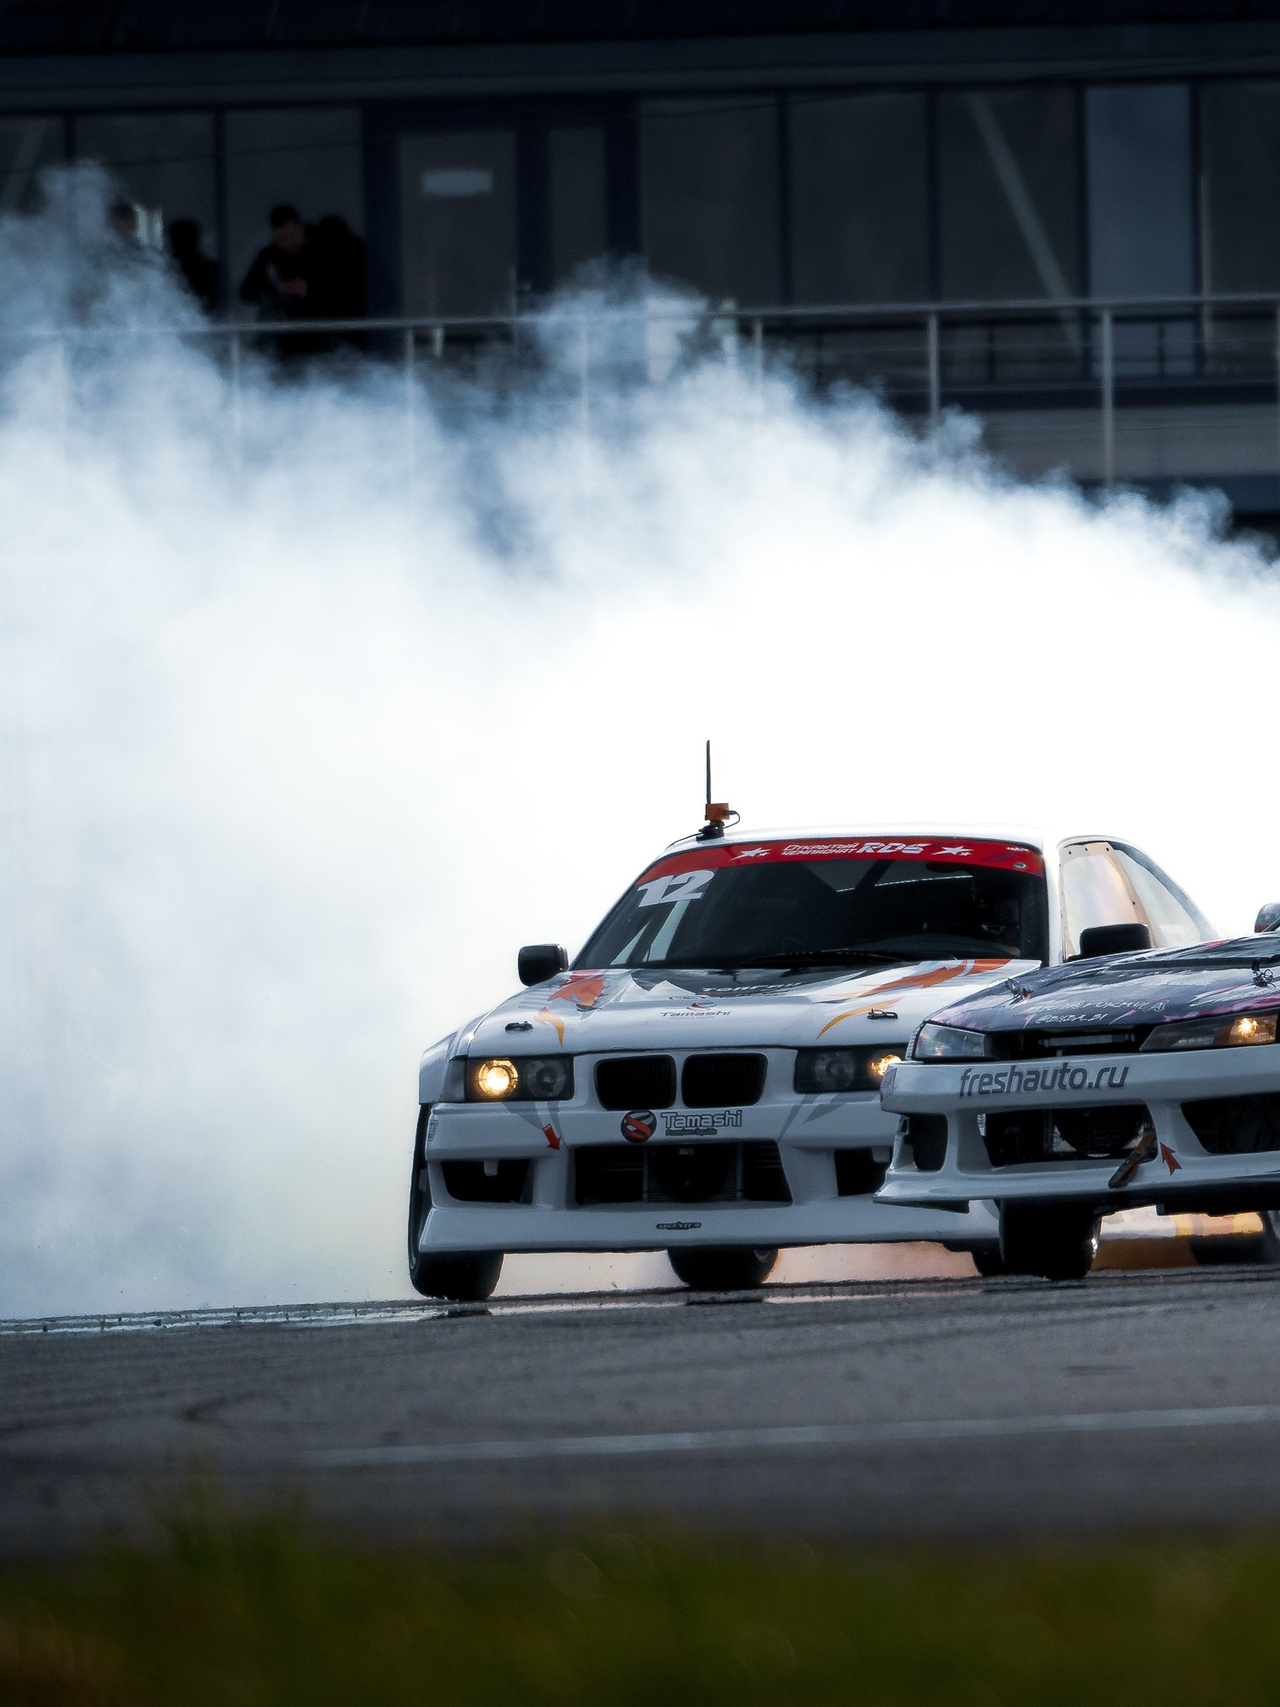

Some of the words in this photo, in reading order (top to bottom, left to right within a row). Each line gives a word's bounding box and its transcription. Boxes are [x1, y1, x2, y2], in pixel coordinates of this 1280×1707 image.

[856, 842, 931, 854] RDS
[637, 869, 715, 907] 12
[660, 1010, 732, 1018] Tamashi
[959, 1062, 1130, 1098] freshauto.ru
[660, 1109, 743, 1129] Tamashi
